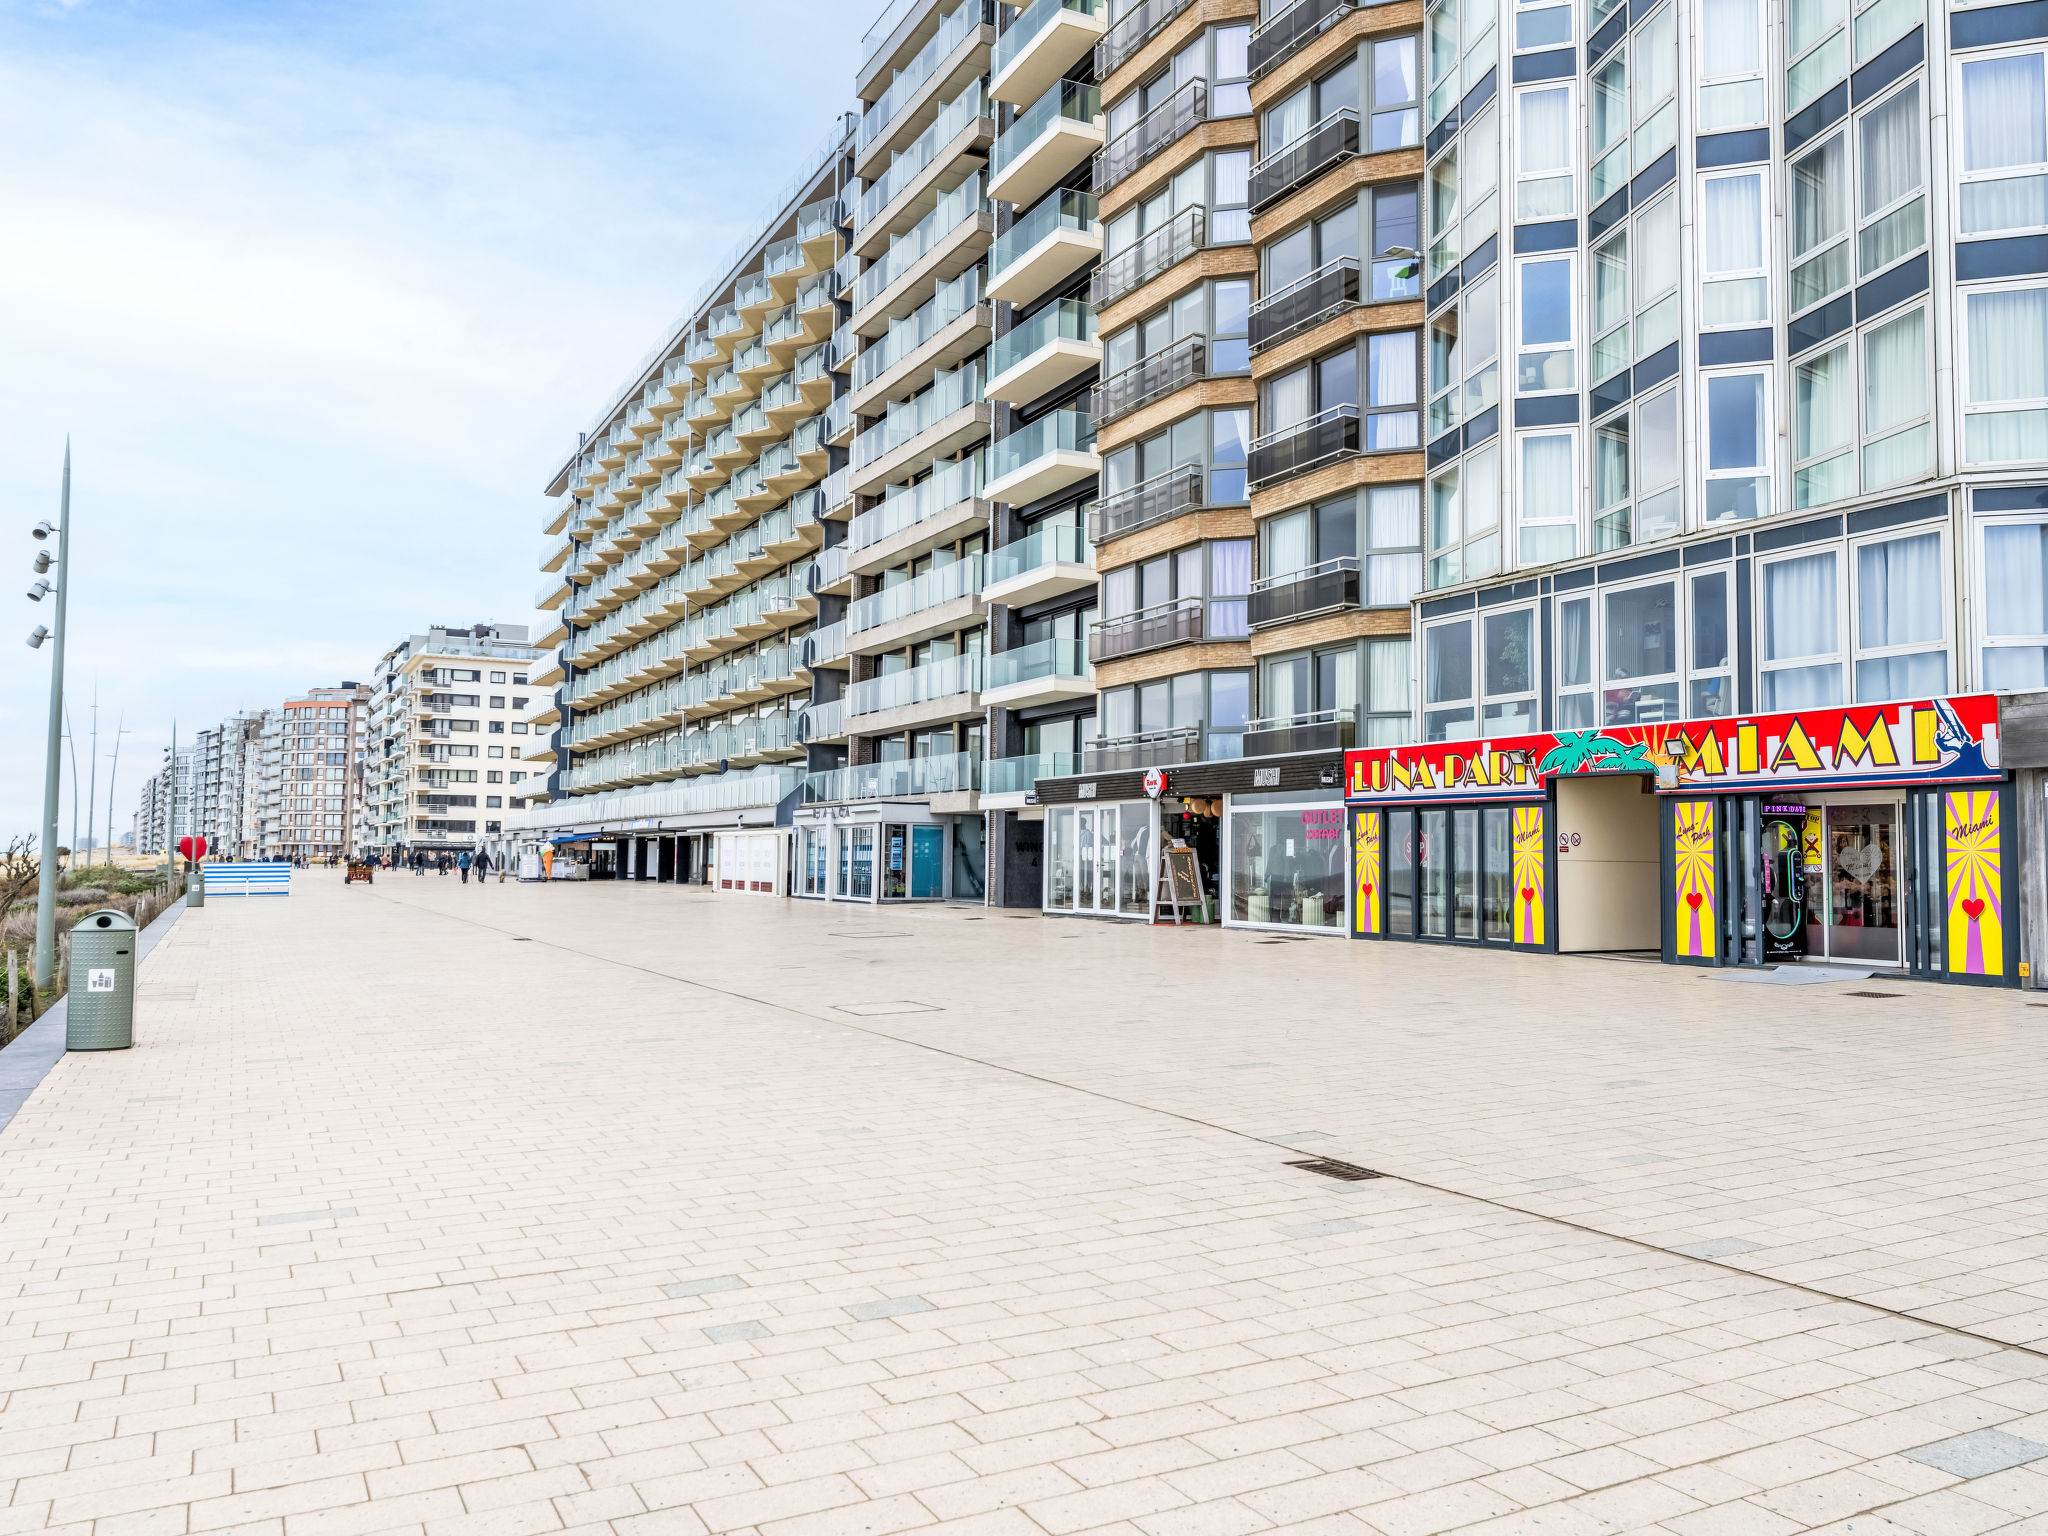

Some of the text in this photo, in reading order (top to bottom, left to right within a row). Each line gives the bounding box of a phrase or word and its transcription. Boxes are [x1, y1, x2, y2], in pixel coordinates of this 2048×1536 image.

[1677, 708, 1941, 776] MIAMI
[1254, 767, 1280, 788] MUSHI
[1353, 747, 1539, 792] LUNA PARK
[1300, 809, 1345, 824] OUTLET
[1805, 814, 1820, 823] TOP
[1305, 828, 1340, 840] corner
[1516, 824, 1540, 844] Miami
[1677, 822, 1699, 838] Luna-
[1691, 826, 1711, 844] Park
[1952, 815, 1994, 840] Miami
[1365, 832, 1378, 845] Park
[1406, 842, 1425, 853] SP
